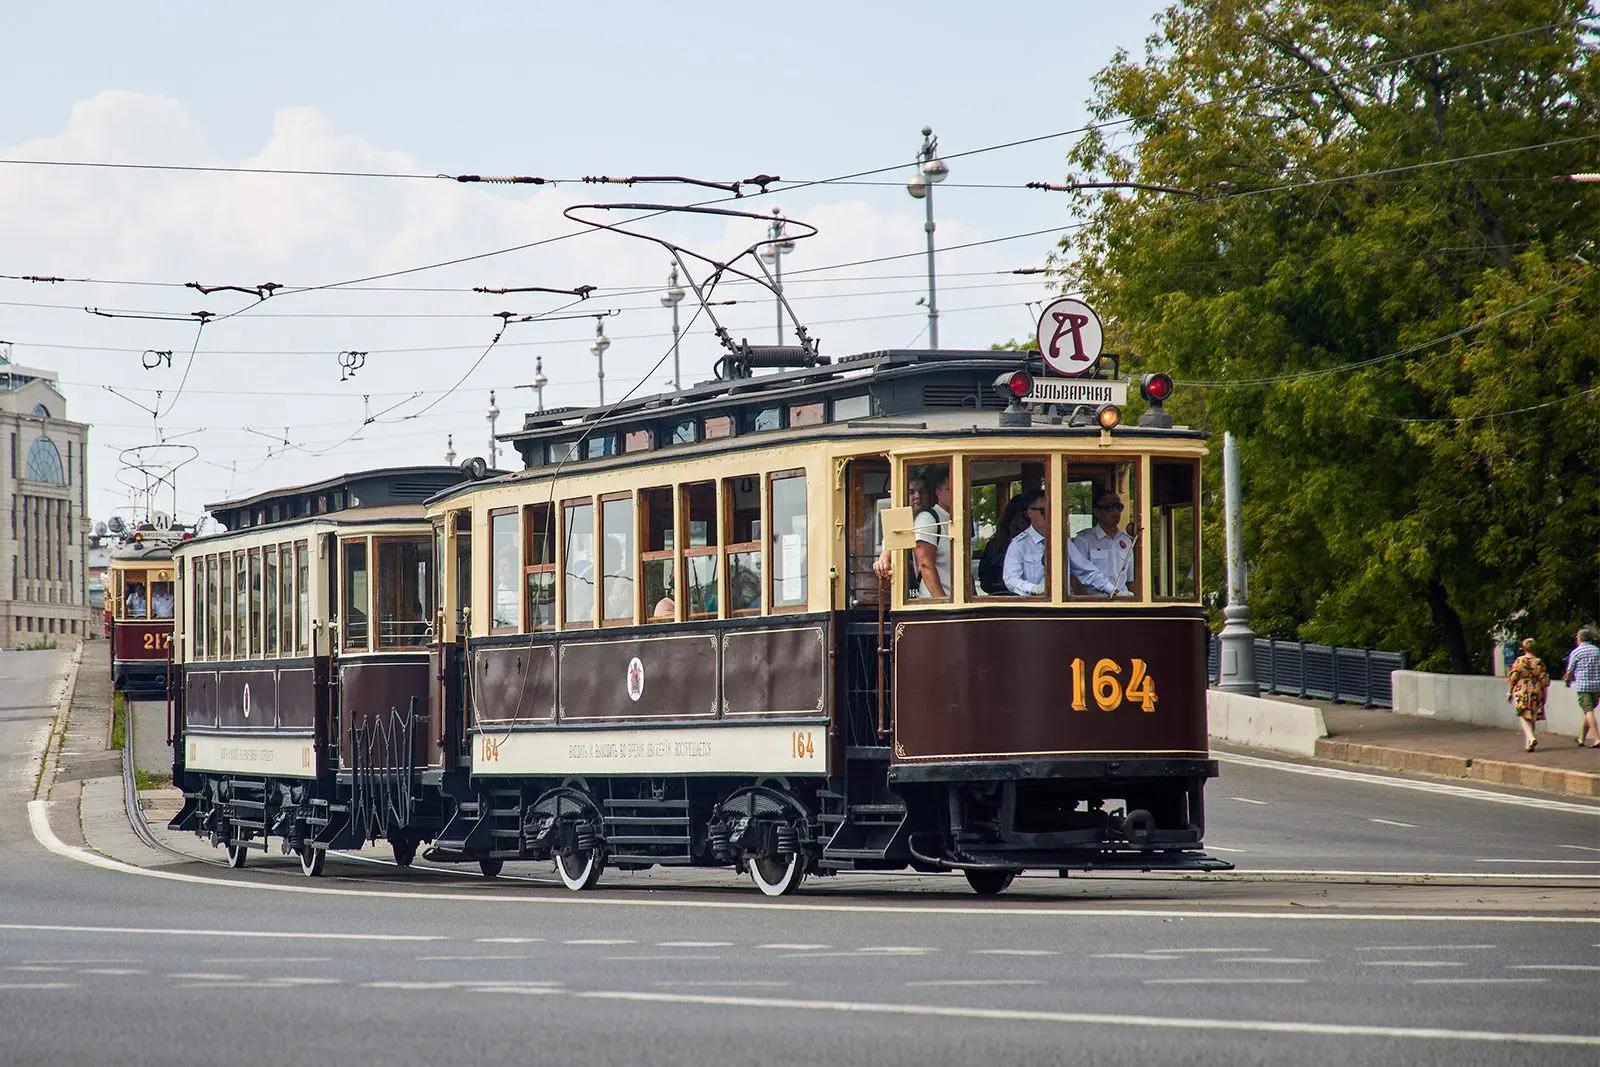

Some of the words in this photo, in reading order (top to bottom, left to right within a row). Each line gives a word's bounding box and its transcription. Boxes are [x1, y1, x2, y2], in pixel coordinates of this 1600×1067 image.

[1027, 383, 1112, 402] УЛЬВАРНАЯ
[143, 633, 170, 650] 217
[1070, 658, 1158, 713] 164
[481, 736, 499, 762] 164
[793, 731, 814, 759] 164
